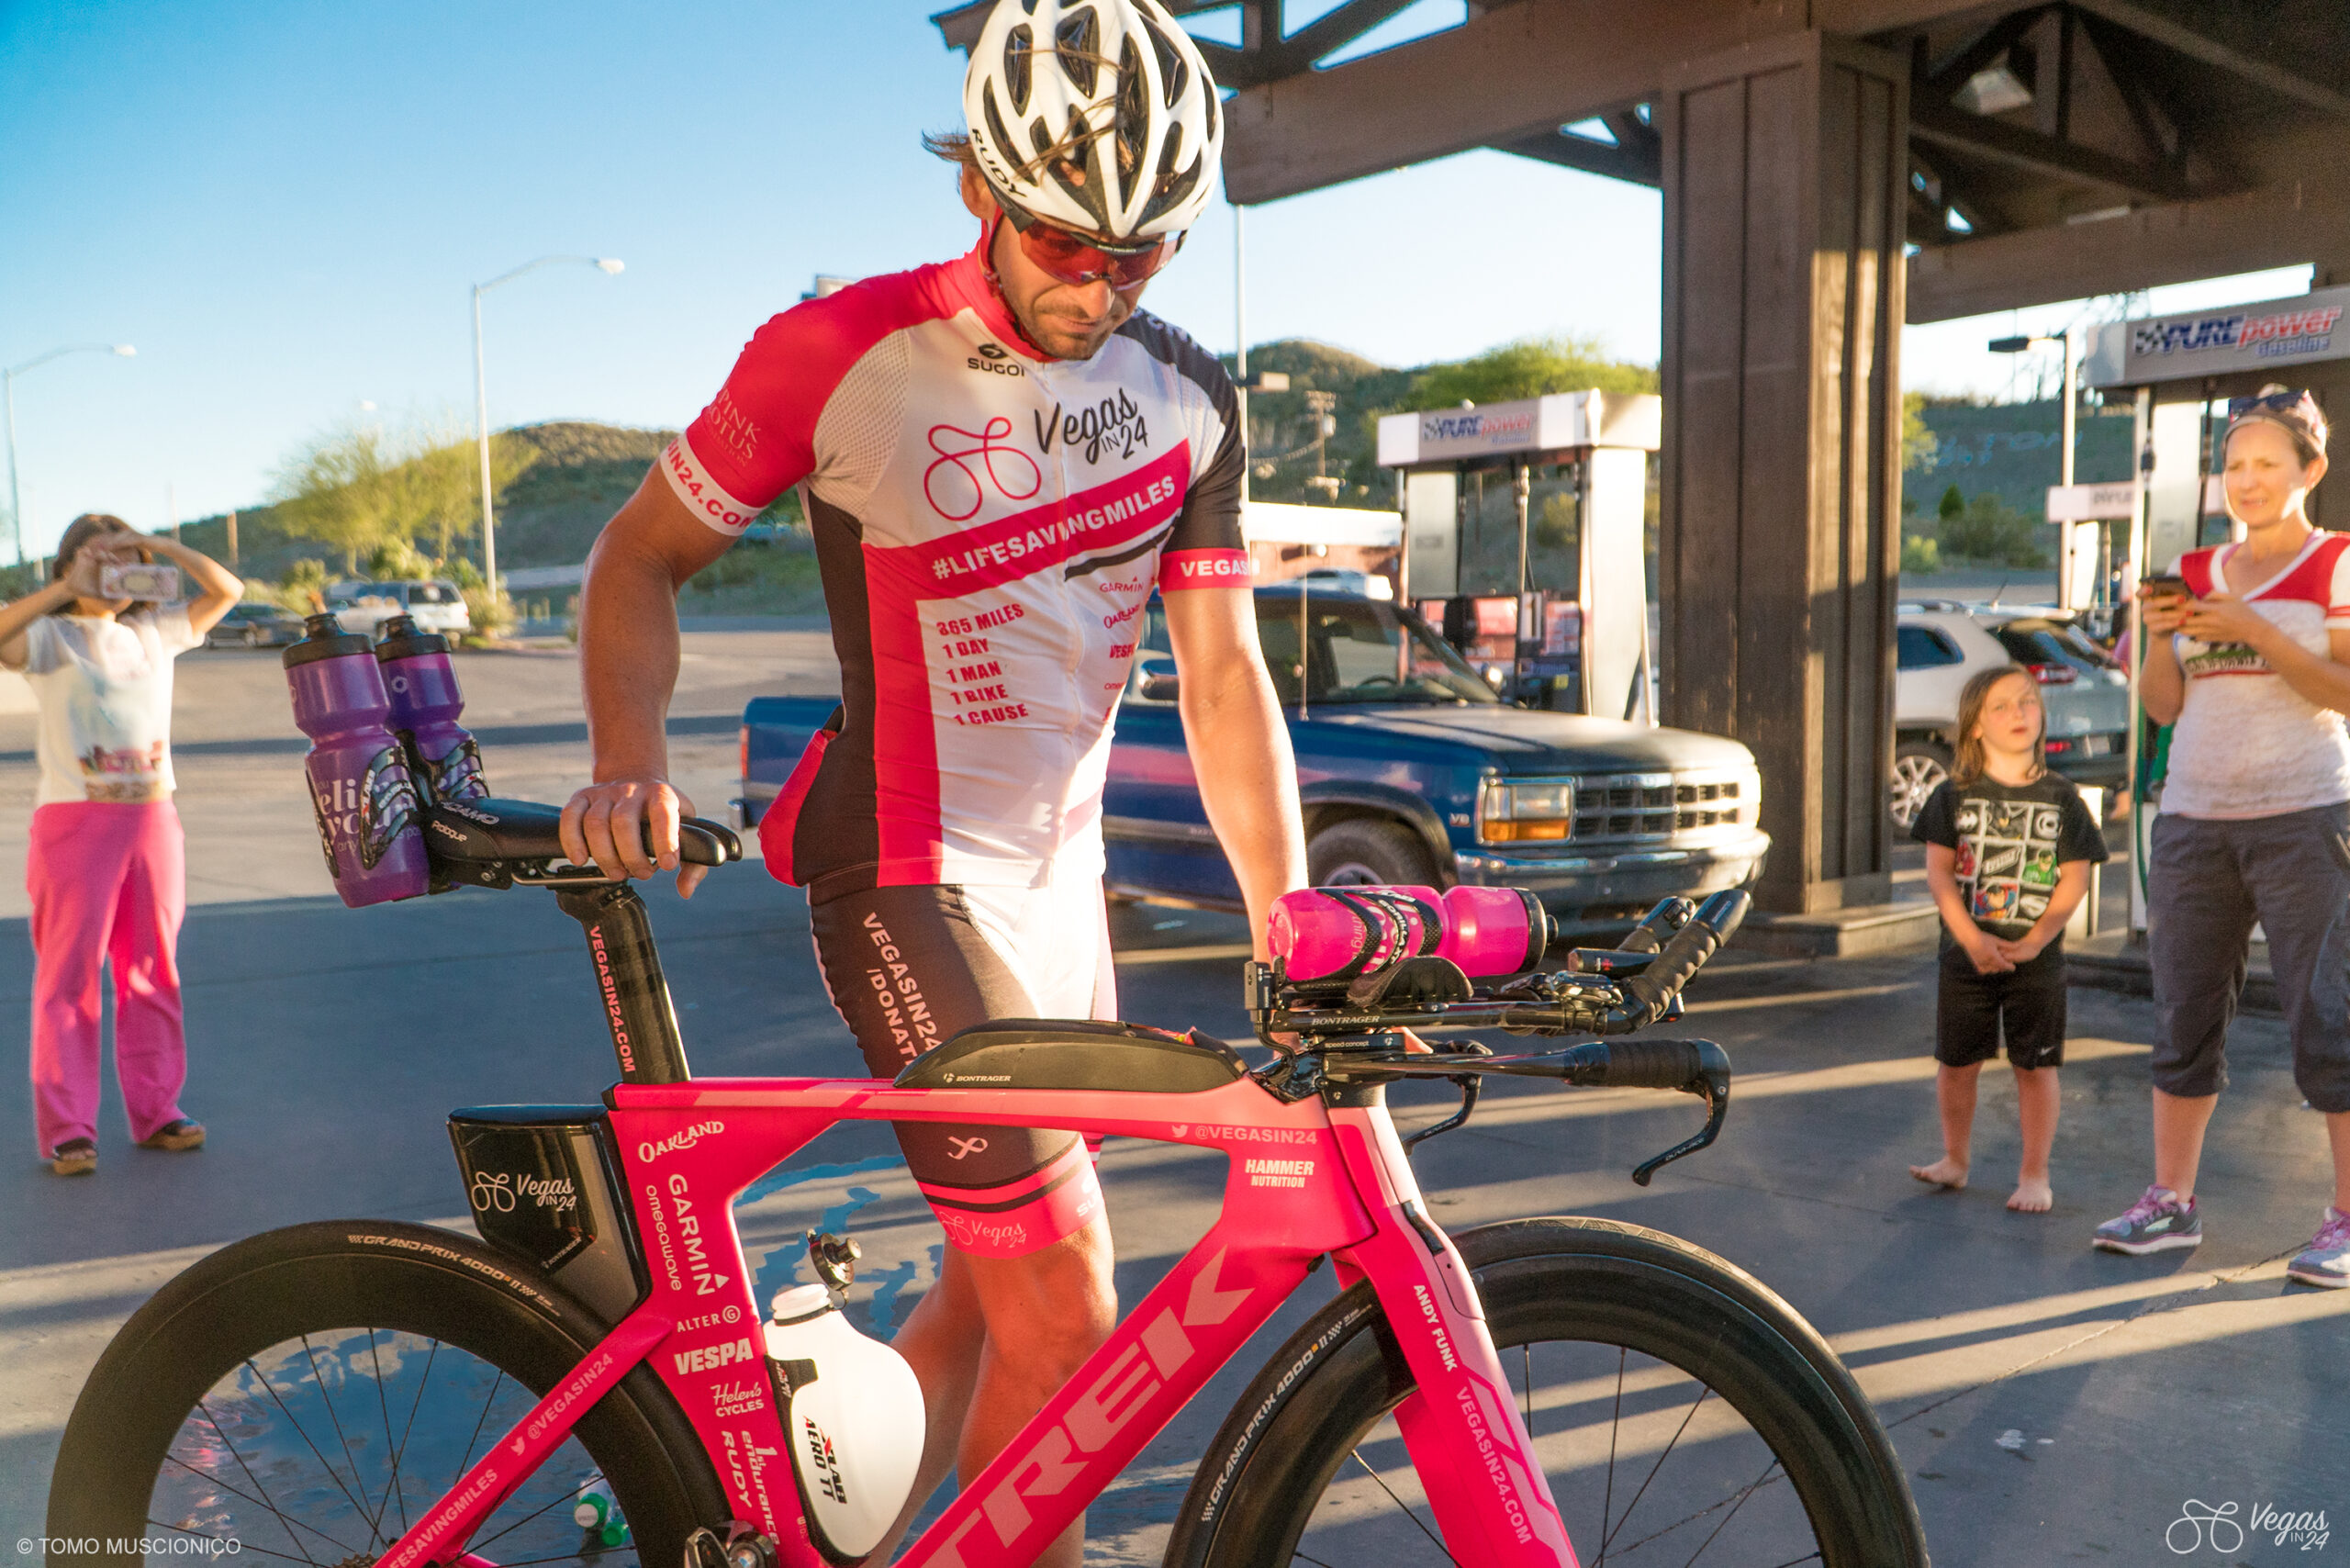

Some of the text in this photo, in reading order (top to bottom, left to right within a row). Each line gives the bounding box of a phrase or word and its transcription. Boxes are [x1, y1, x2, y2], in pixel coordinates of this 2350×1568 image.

[971, 128, 1027, 198] RUDY
[2163, 307, 2342, 356] PURE power
[967, 357, 1025, 377] SUGOI
[711, 406, 756, 459] OTUS
[717, 388, 762, 442] PINK
[1034, 386, 1138, 465] Vegas
[1101, 415, 1148, 461] IN 24
[932, 475, 1176, 581] #LIFESAVINGMILES
[1099, 580, 1145, 594] GARMIN
[935, 602, 1025, 636] 365 MILES
[942, 637, 990, 660] 1 DAY
[946, 660, 1003, 684] 1 MAN
[950, 683, 1010, 706] 1 BIKE
[954, 702, 1030, 726] 1 CAUSE
[589, 924, 637, 1073] VEGASIN24.COM
[865, 969, 919, 1066] /DONAT
[1311, 1015, 1381, 1026] BONTRAGER
[956, 1074, 1013, 1082] BONTRAGER
[638, 1120, 725, 1163] OAKLAND
[1195, 1125, 1318, 1145] @VEGASIN24
[1245, 1159, 1315, 1176] HAMMER
[1251, 1175, 1305, 1188] NUTRITION
[516, 1173, 575, 1209] Vegas
[544, 1195, 577, 1213] IN 24
[364, 1234, 420, 1251] GRAND
[419, 1244, 461, 1263] PRIX
[645, 1184, 683, 1292] omegawave
[668, 1173, 715, 1296] GARMIN
[971, 1219, 1026, 1247] Vegas
[677, 1313, 722, 1334] ALTER
[1413, 1284, 1458, 1372] ANDY FUNK
[674, 1337, 754, 1376] VESPA
[527, 1352, 614, 1440] @VEGASIN24
[710, 1379, 763, 1406] Helen's
[716, 1397, 765, 1418] CYCLES
[802, 1414, 827, 1470] AERO
[1209, 1437, 1249, 1506] GRAND
[1246, 1392, 1278, 1442] PRIX
[721, 1430, 753, 1508] RUDY
[1456, 1386, 1533, 1545] VEGASIN24.COM
[741, 1430, 781, 1547] endurance
